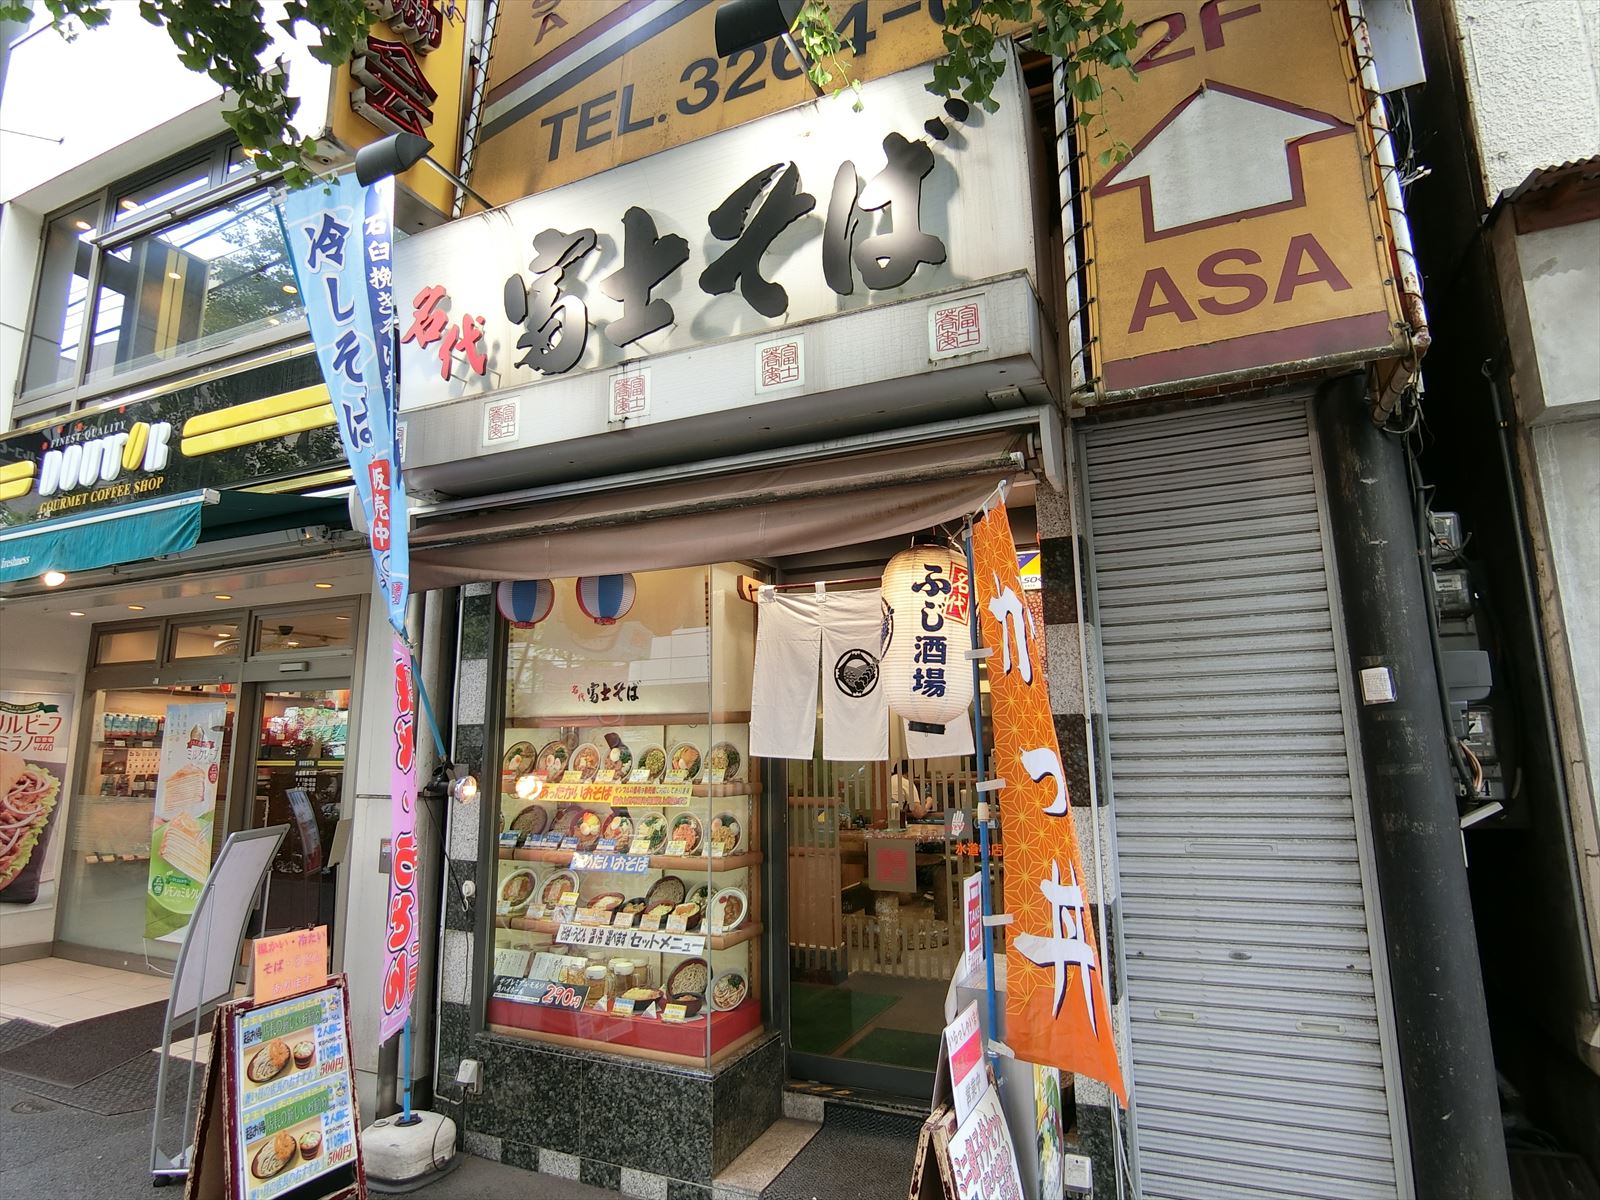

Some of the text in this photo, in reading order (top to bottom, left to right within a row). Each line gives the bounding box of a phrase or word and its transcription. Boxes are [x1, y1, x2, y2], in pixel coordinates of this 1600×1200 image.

[401, 97, 970, 382] 名代 富士そば
[1127, 232, 1353, 335] ASA
[51, 420, 127, 449] FINEST QUALITY
[38, 421, 172, 497] DOUTOR
[39, 477, 164, 514] GOURMET COFFEE SHOP
[944, 571, 970, 622] 名代
[911, 563, 952, 698] ふじ酒場
[574, 854, 650, 873] めたいおそば
[955, 841, 1003, 857] 水道店
[630, 932, 704, 952] セットメニュー
[541, 983, 582, 1009] 290円
[320, 1056, 344, 1075] 500円
[327, 1143, 352, 1165] 500円
